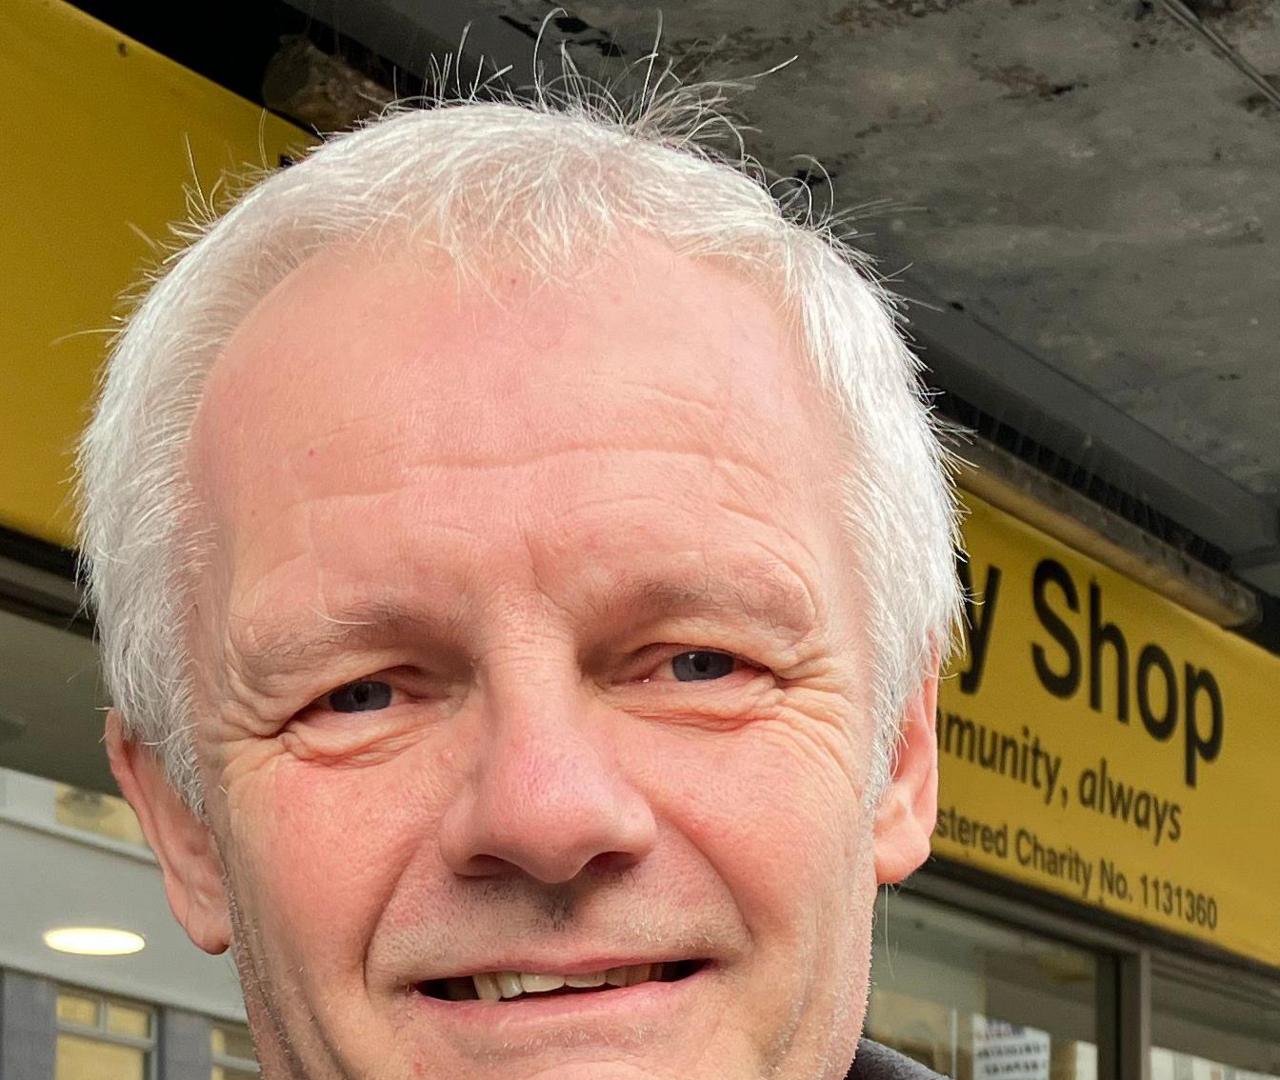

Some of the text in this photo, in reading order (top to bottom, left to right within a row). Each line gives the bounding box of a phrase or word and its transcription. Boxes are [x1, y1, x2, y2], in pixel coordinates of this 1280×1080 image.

[959, 557, 1223, 788] y Shop
[937, 706, 1182, 846] munity, always
[937, 805, 1218, 930] stered Charity No. 1131360
